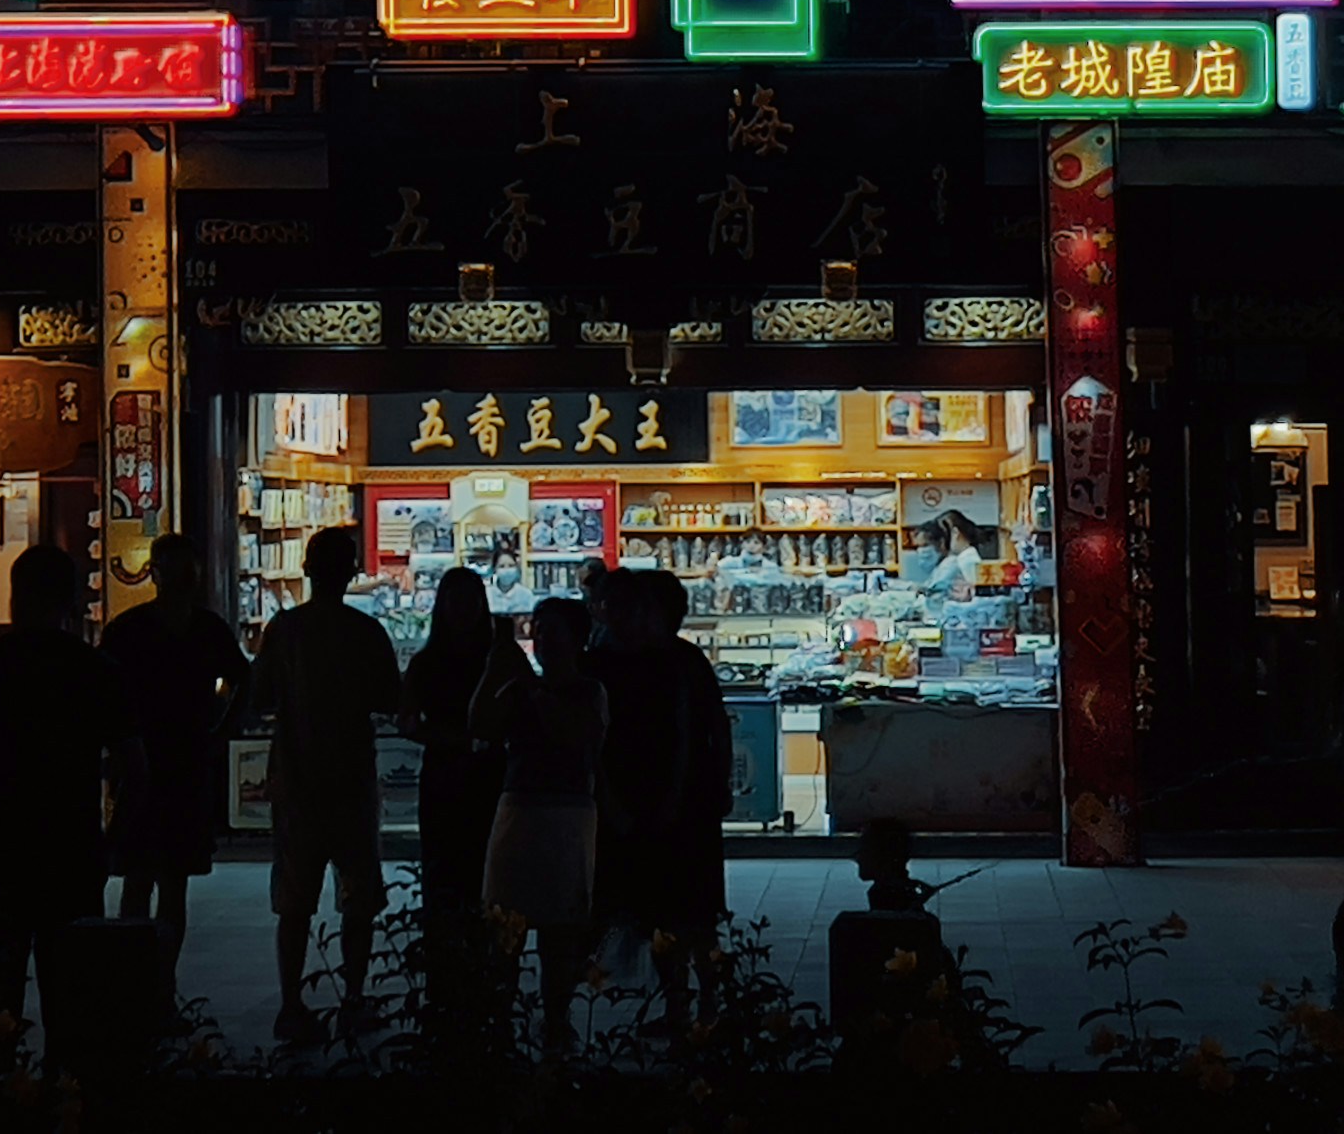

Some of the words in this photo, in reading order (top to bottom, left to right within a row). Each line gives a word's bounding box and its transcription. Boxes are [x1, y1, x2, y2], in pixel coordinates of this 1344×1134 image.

[997, 39, 1238, 99] 老城隍庙
[514, 83, 796, 157] 上海
[411, 393, 666, 456] 五香豆大王
